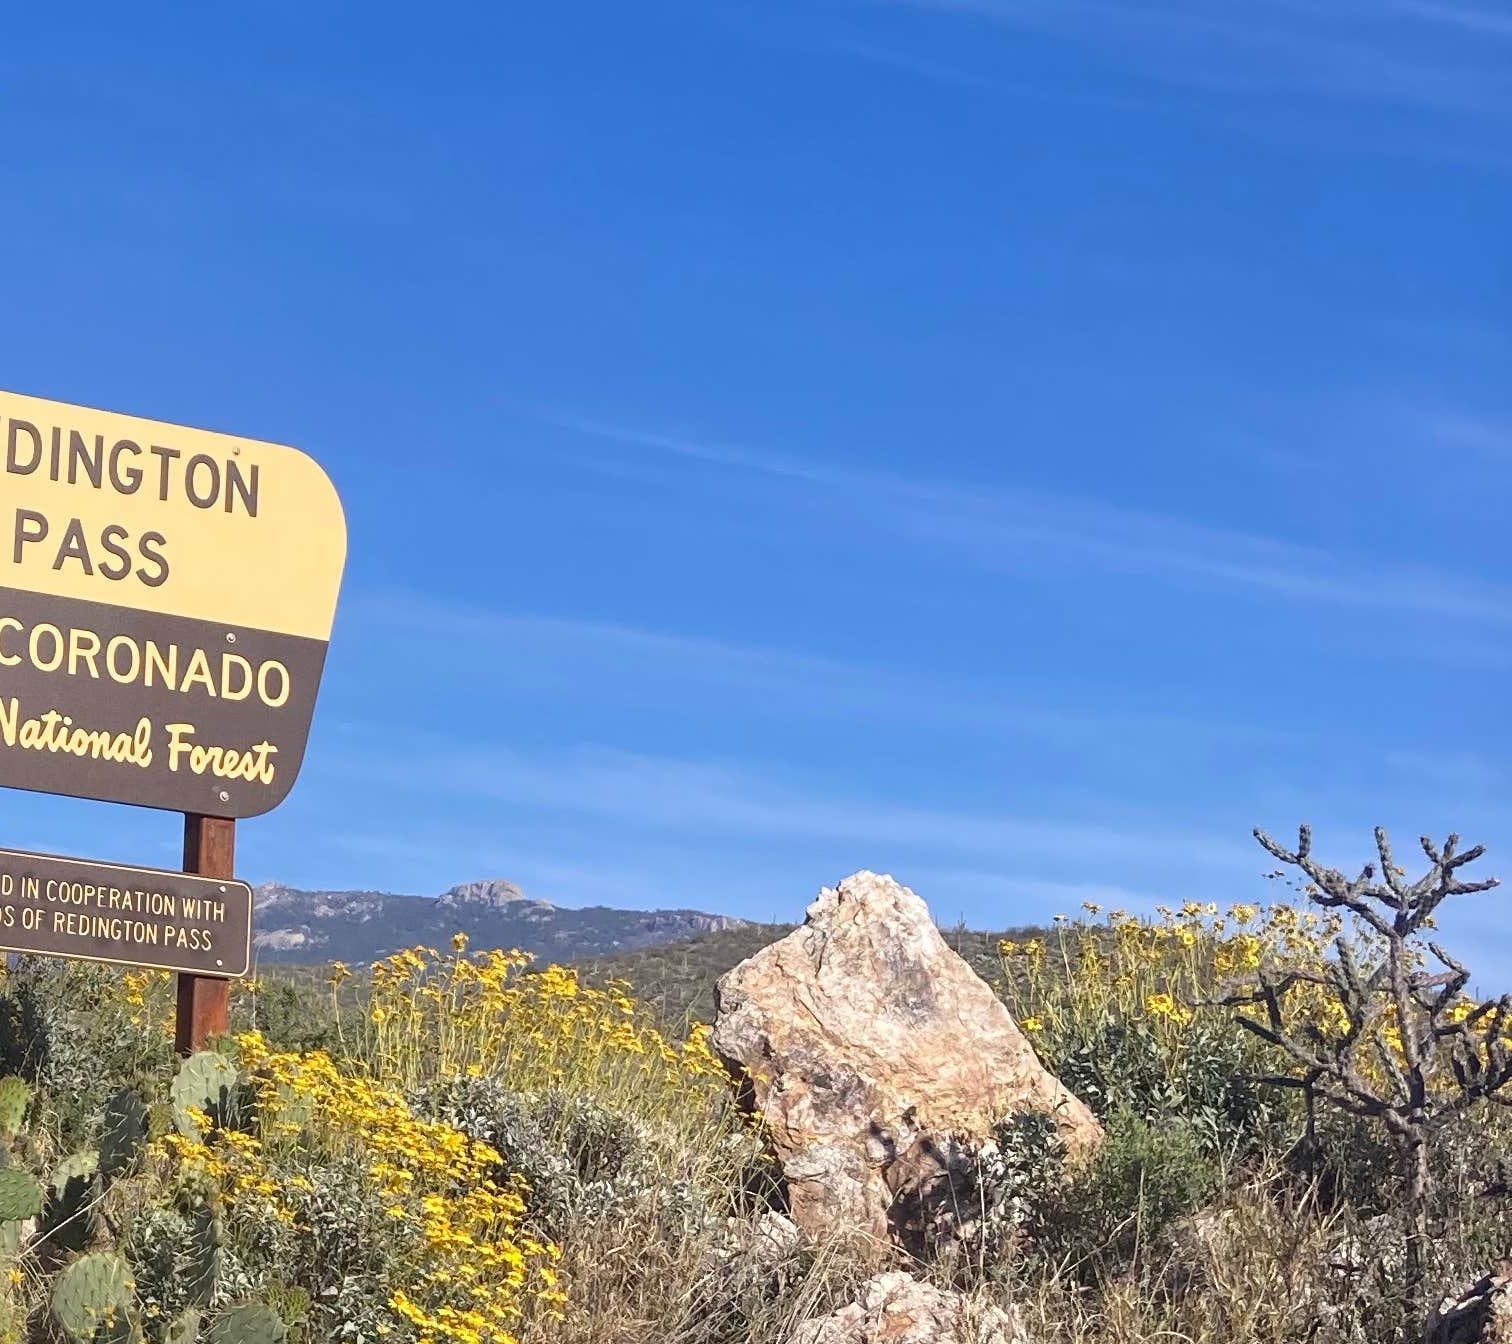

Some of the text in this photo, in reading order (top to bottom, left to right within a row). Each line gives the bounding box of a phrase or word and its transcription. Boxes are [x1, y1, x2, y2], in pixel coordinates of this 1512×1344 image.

[13, 507, 170, 588] PASS
[164, 722, 279, 785] Forest
[20, 876, 40, 900] IN
[45, 879, 176, 917] COOPERATION
[181, 897, 226, 923] WITH
[21, 906, 47, 931] OF
[52, 911, 158, 946] REDINGTON
[163, 925, 213, 952] PASS
